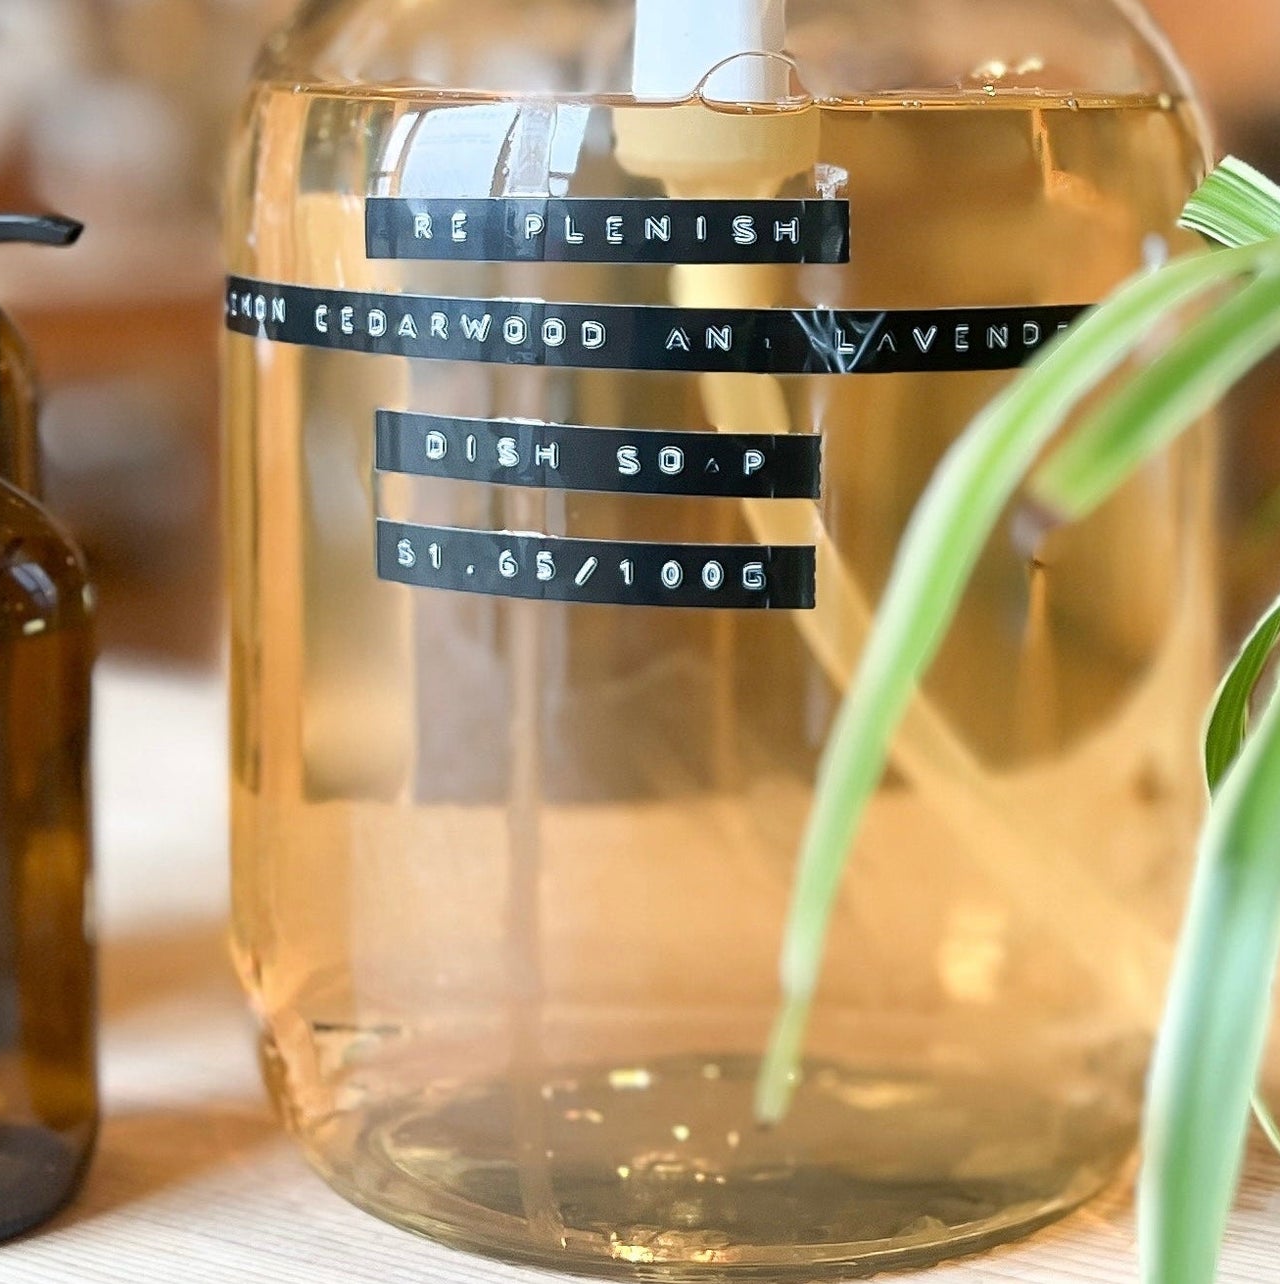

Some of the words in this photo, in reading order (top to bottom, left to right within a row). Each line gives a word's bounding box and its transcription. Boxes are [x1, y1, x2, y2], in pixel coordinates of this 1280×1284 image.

[412, 209, 469, 243] RE
[524, 211, 800, 246] PLENISH
[315, 304, 608, 350] CEDARWOOD
[664, 324, 773, 353] AN
[833, 319, 1069, 355] LAVEND
[424, 429, 561, 471] DISH
